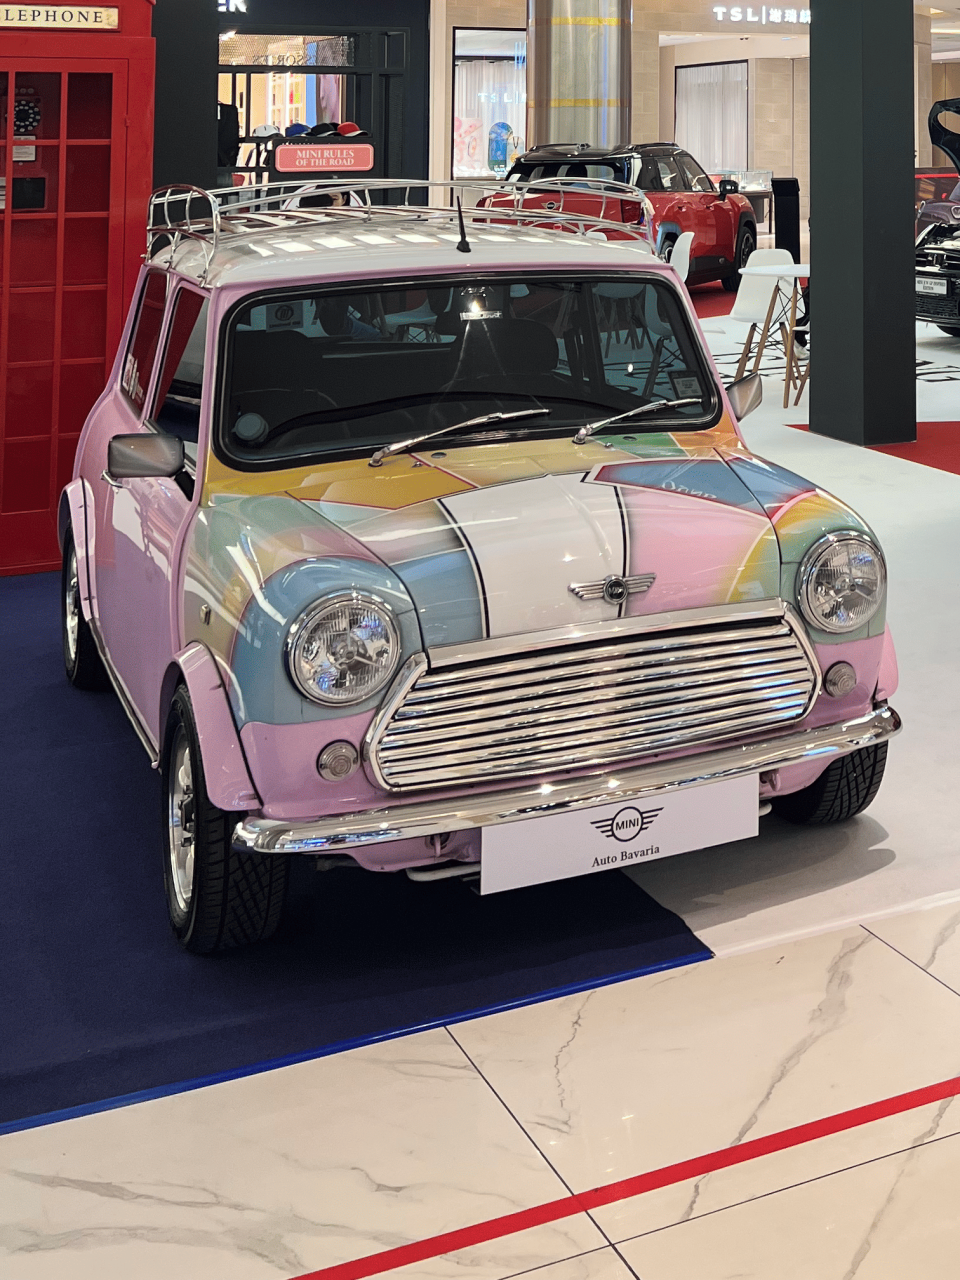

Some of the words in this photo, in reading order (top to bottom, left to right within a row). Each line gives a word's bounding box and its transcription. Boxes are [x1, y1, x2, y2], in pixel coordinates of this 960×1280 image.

[712, 6, 759, 22] TSL
[296, 149, 321, 159] MINI
[323, 149, 355, 159] RULES
[295, 158, 308, 167] OF
[310, 158, 329, 167] THE
[329, 157, 355, 166] ROAD
[615, 817, 640, 832] MINI
[591, 854, 617, 868] Auto
[620, 844, 660, 862] Bavaria
